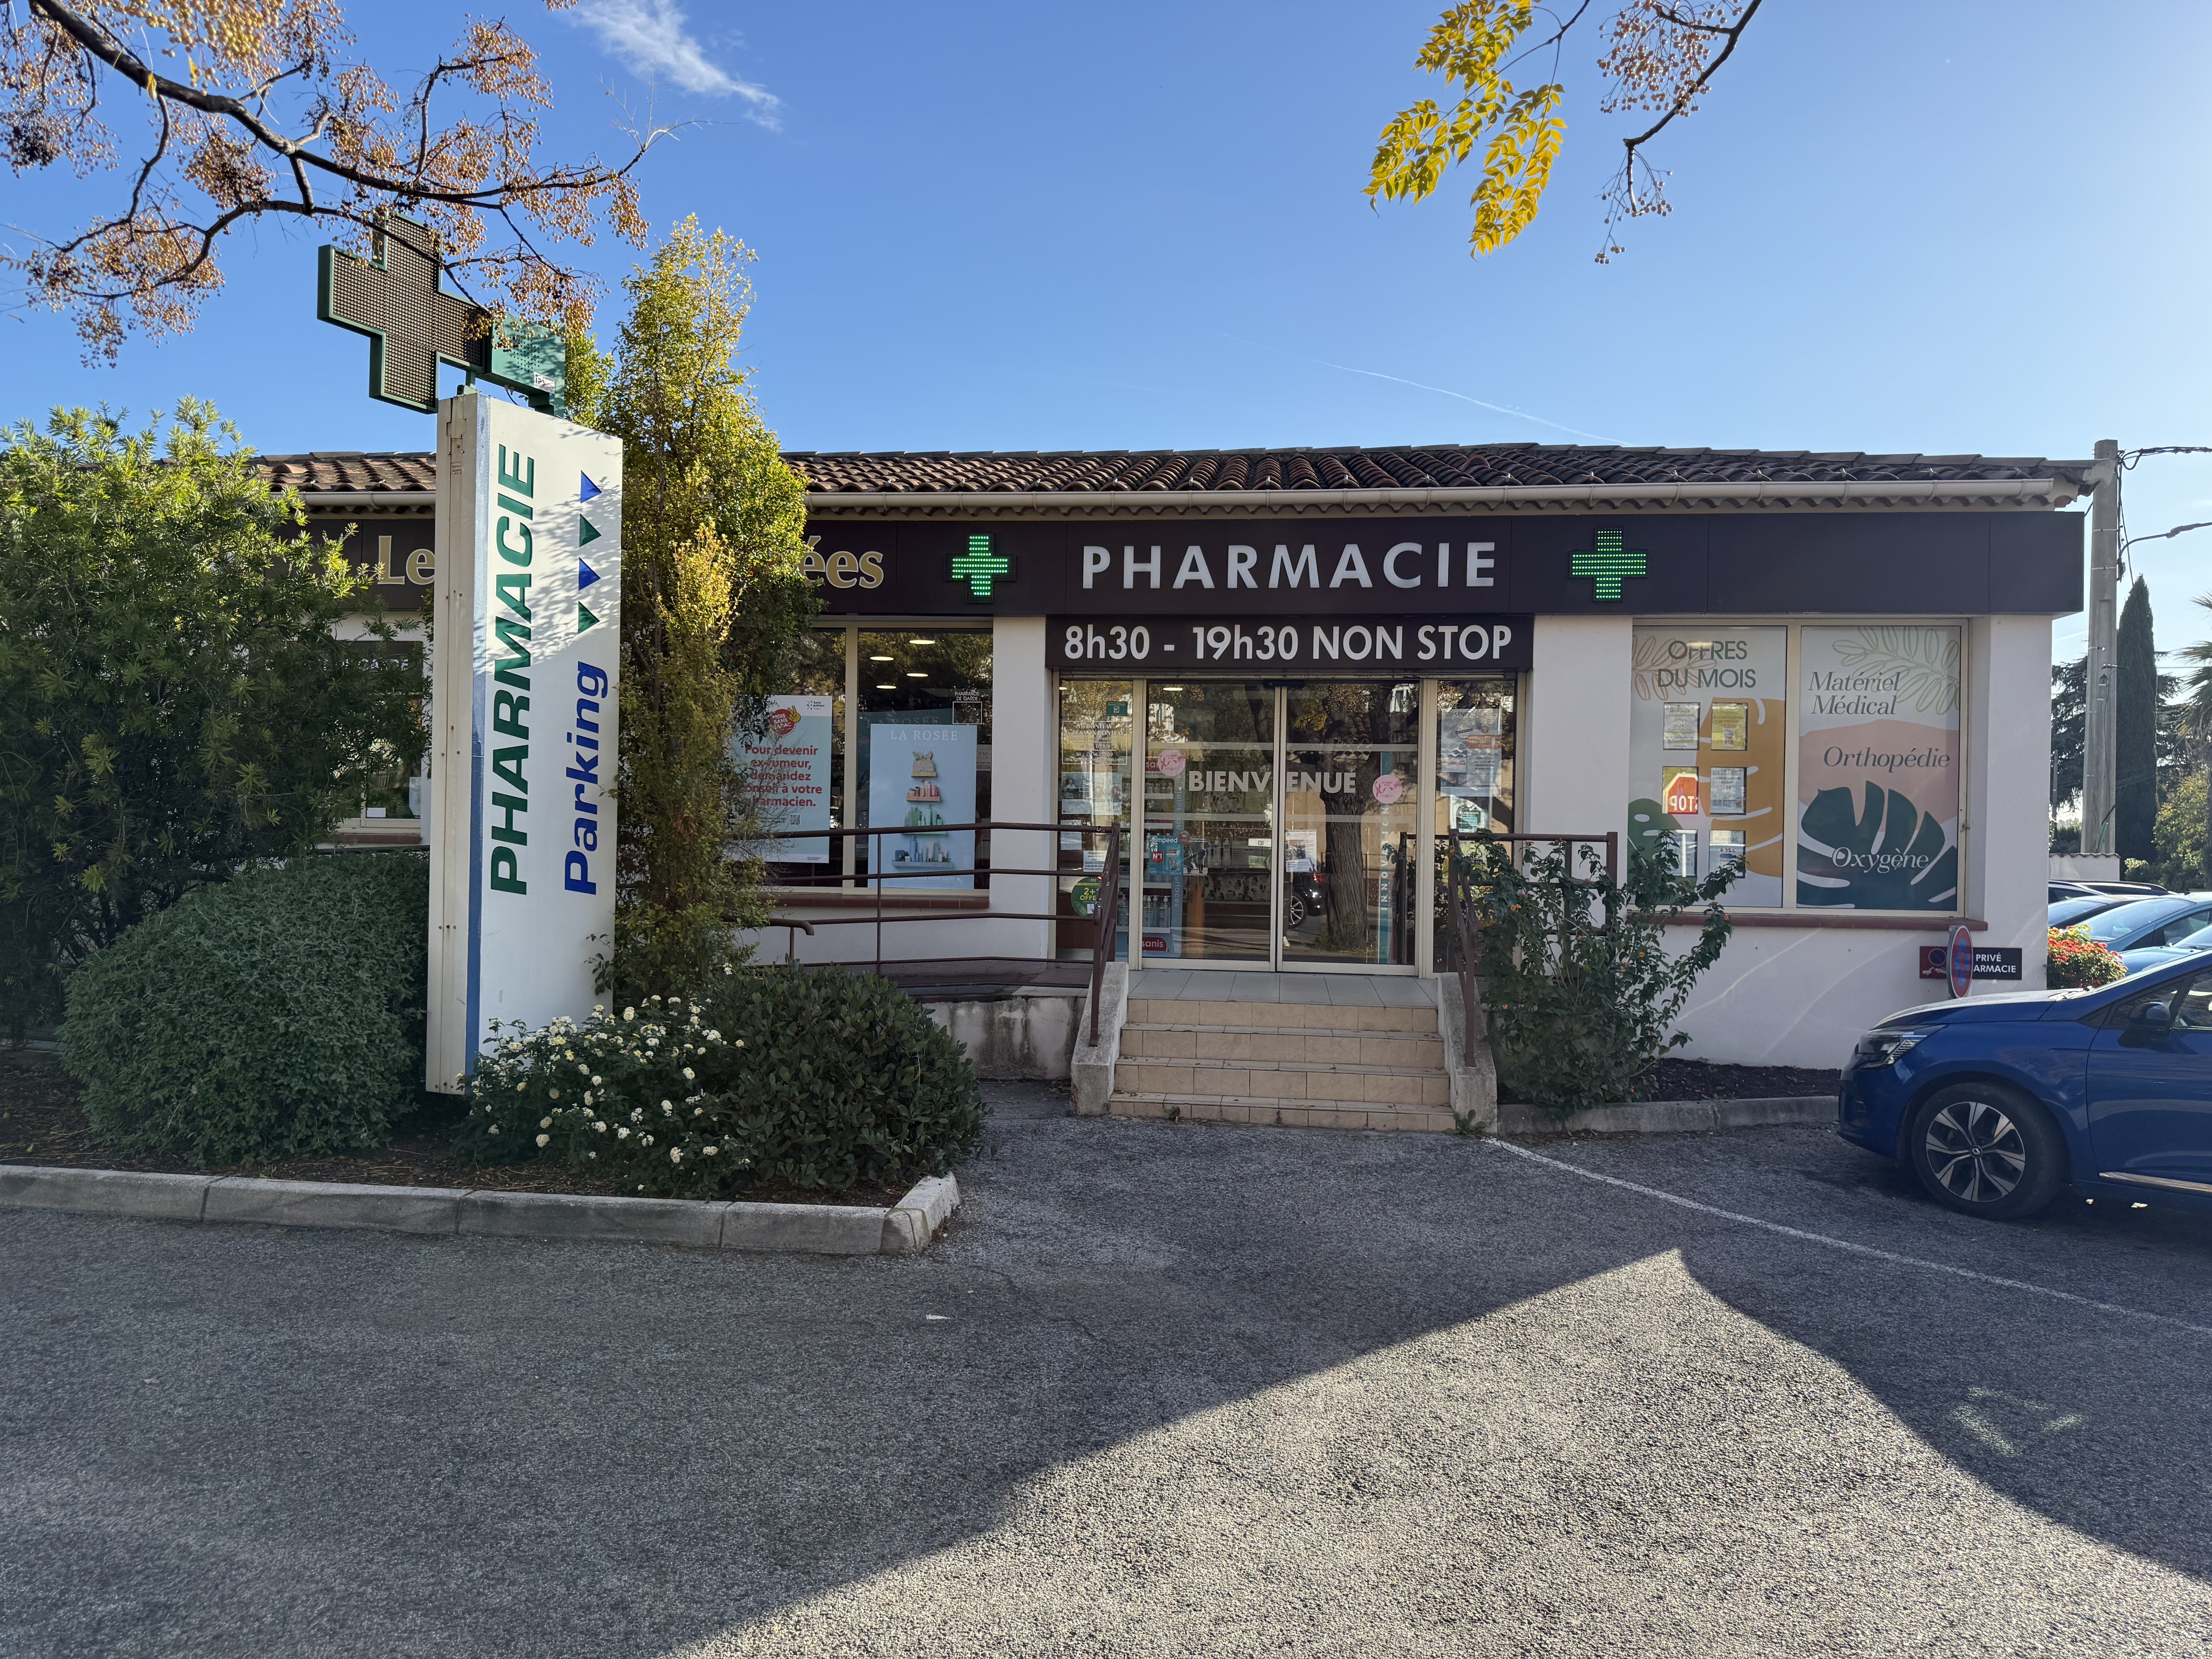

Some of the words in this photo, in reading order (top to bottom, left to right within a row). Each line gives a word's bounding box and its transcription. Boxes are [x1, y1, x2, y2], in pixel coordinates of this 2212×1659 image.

[378, 535, 435, 585] Le
[799, 535, 884, 589] ées
[1082, 542, 1495, 589] PHARMACIE
[1065, 624, 1150, 659] 8h30
[1193, 624, 1298, 660] 19h30
[1313, 625, 1403, 660] NON
[1417, 624, 1511, 660] STOP
[1668, 640, 1747, 660] OFFRES
[491, 444, 534, 895] PHARMACIE
[1658, 668, 1688, 688] DU
[1698, 668, 1756, 689] MOIS
[1808, 672, 1901, 691] Matériel
[1811, 695, 1896, 714] Médical
[890, 730, 907, 740] LA
[914, 728, 958, 740] ROSÉE
[745, 744, 771, 754] Pour
[774, 744, 818, 756] devenir
[1824, 747, 1950, 773] Orthopédie
[565, 661, 608, 895] Parking
[782, 783, 788, 793] à
[791, 785, 823, 794] votre
[1832, 847, 1929, 874] Oxygène
[1976, 952, 2002, 962] PRIVÉ
[1973, 965, 2016, 973] ARMACIE
